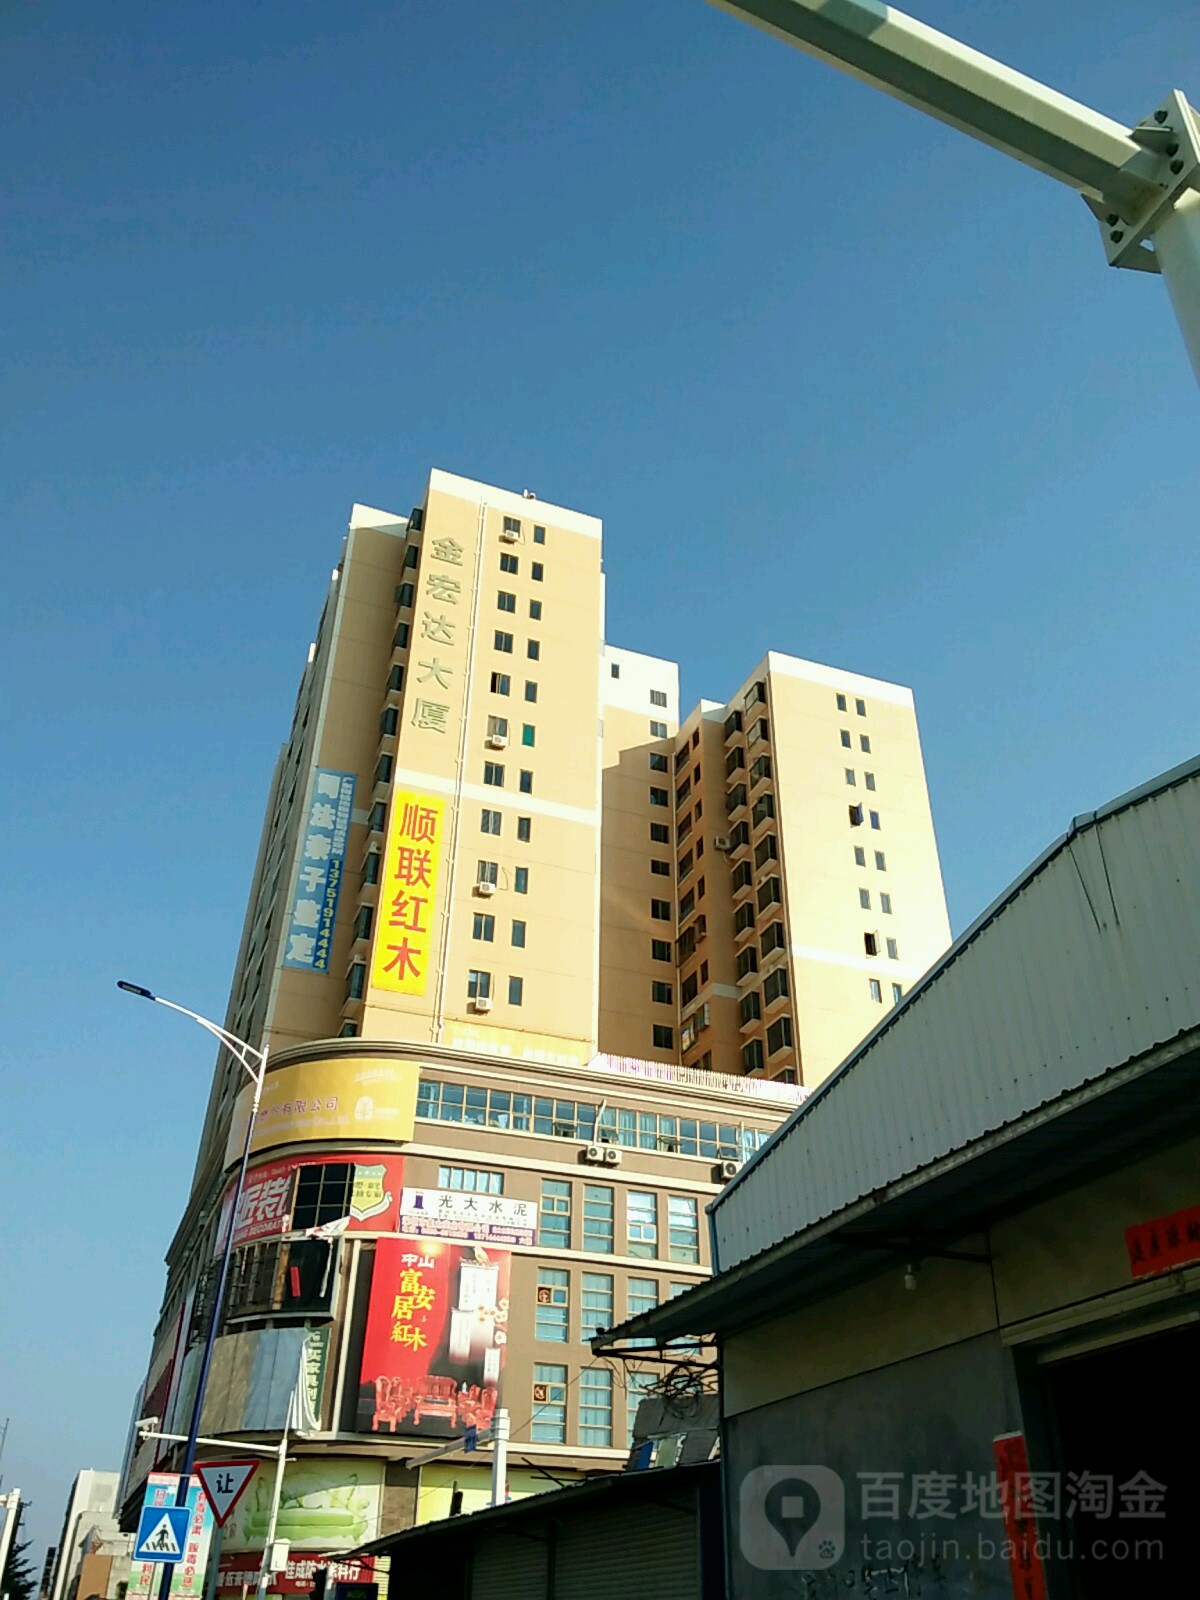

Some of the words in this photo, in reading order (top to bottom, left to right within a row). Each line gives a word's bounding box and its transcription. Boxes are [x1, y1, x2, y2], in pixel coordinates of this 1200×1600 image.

[411, 537, 463, 735] 金宏达大厦
[286, 773, 341, 964] 司法亲子鉴定
[314, 859, 340, 969] 13751914444
[383, 802, 439, 981] 顺联红木
[401, 1253, 435, 1268] 中山
[438, 1195, 528, 1217] 光大水泥
[216, 1472, 234, 1493] 让
